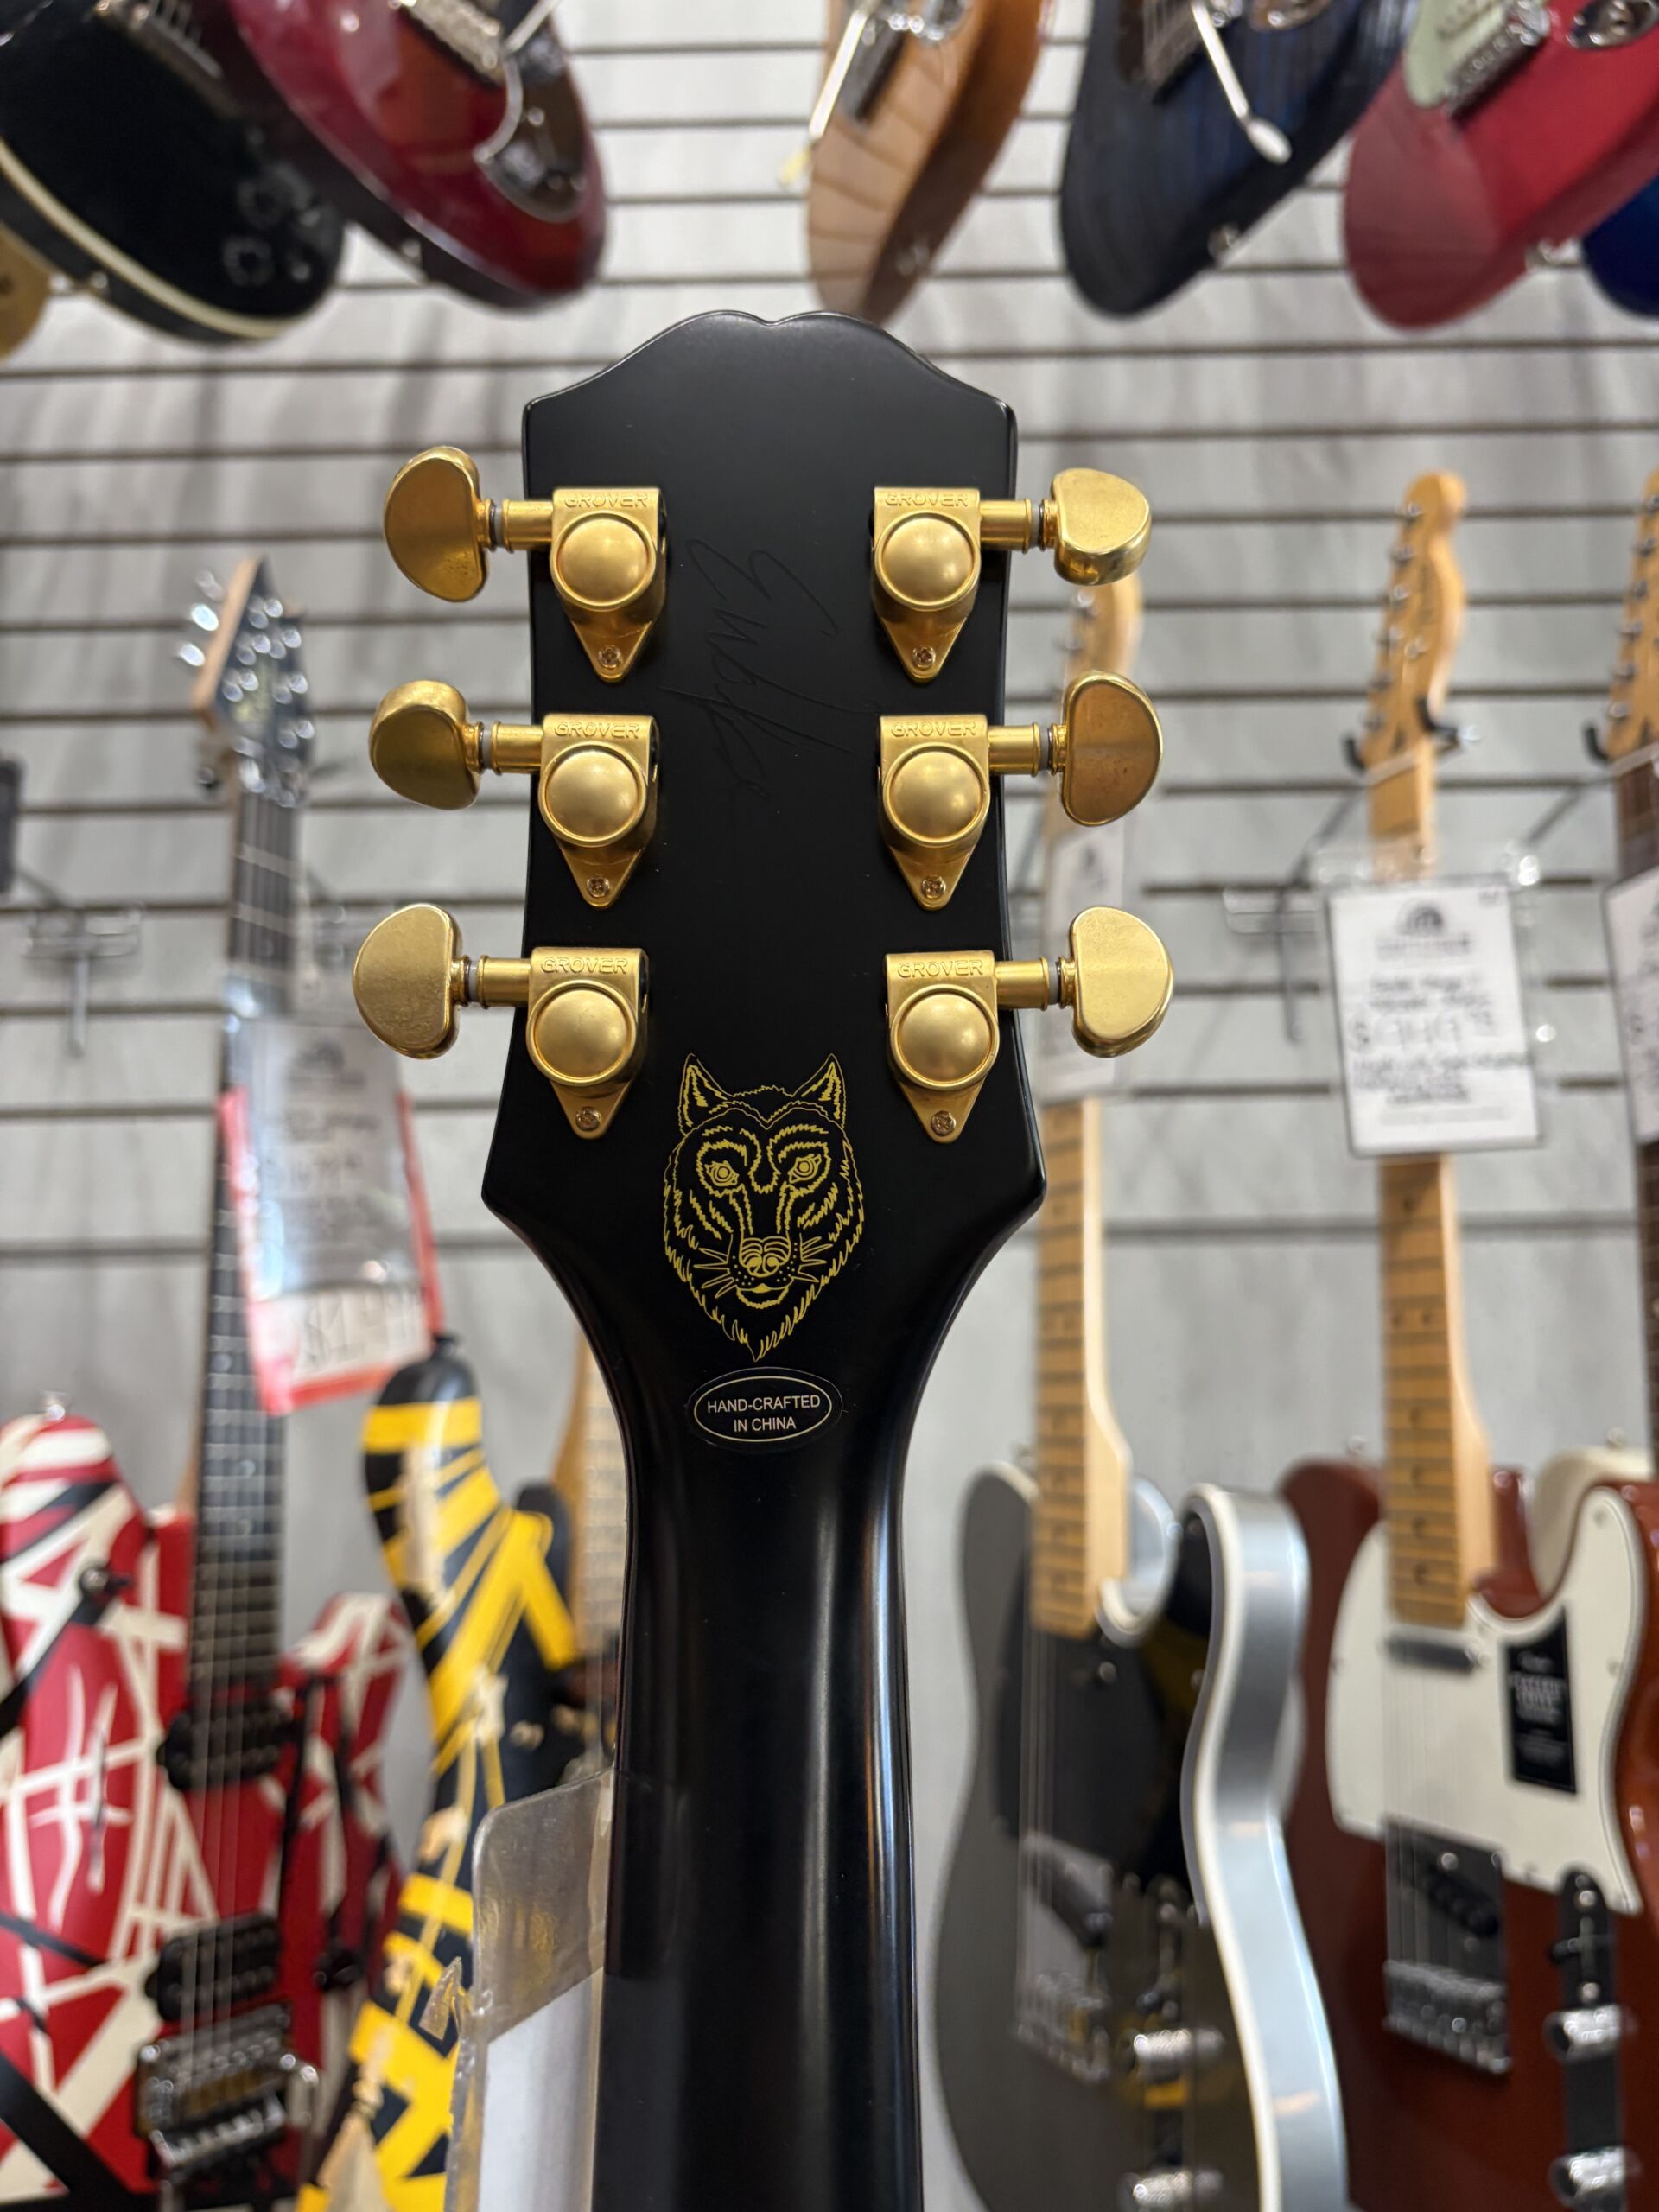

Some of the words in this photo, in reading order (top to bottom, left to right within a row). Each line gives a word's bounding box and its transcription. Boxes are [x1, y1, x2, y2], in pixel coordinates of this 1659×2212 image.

[564, 493, 648, 508] GROVER
[885, 492, 968, 507] GROVER
[554, 721, 639, 739] GROVER
[891, 721, 976, 737] GROVER
[541, 957, 628, 975] GROVER
[897, 959, 983, 978] GROVER
[707, 1394, 821, 1414] HAND-CRAFTED
[734, 1419, 747, 1432] IN
[751, 1416, 797, 1432] CHINA
